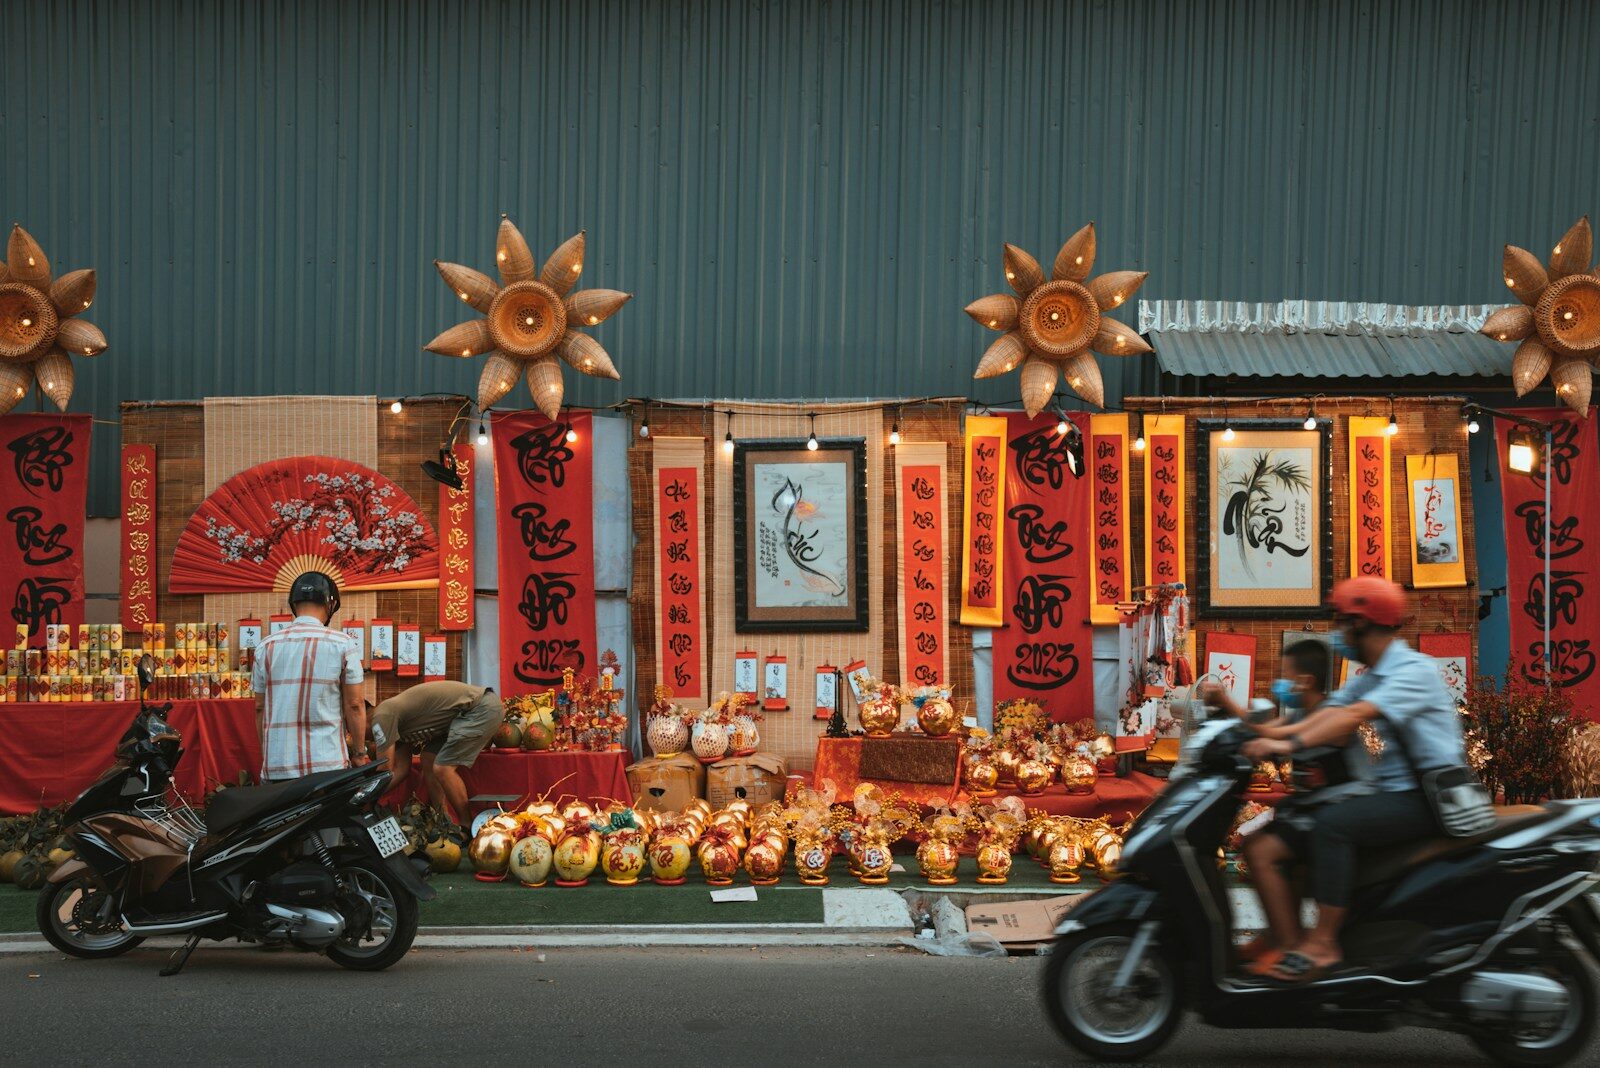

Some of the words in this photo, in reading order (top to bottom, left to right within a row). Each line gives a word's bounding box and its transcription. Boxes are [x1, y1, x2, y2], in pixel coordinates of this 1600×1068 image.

[513, 638, 585, 686] 2023
[1007, 642, 1079, 690] 2023
[1520, 639, 1596, 689] 2023
[372, 820, 397, 840] 59-F1
[379, 832, 407, 855] 533.53
